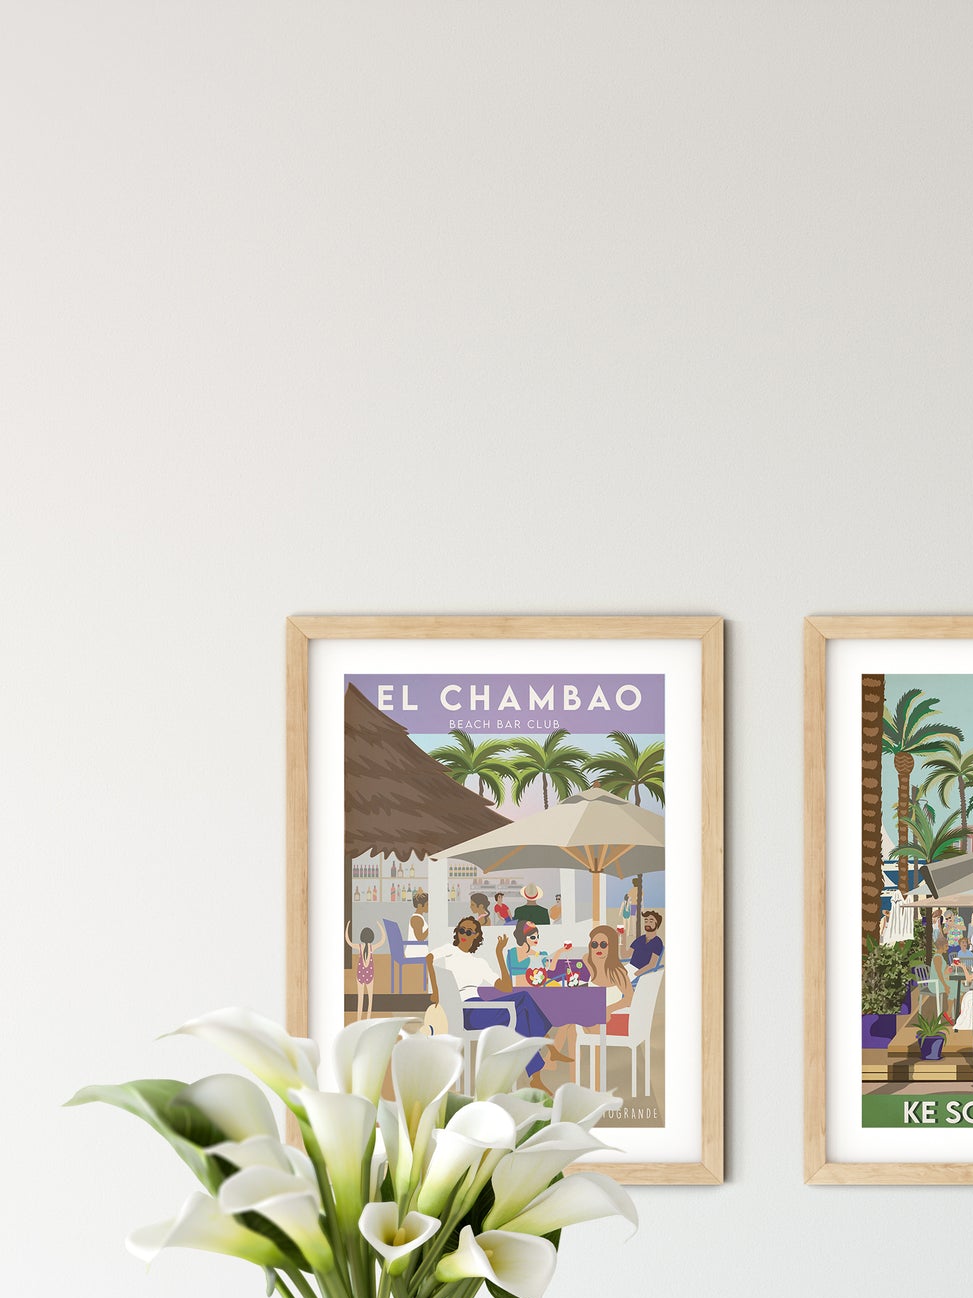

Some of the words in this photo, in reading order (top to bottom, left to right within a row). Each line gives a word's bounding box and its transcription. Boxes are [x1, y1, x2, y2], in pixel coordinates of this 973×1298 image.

[377, 684, 418, 711] EL
[440, 684, 642, 711] CHAMBAO
[449, 719, 490, 729] BEACH
[497, 719, 521, 729] BAR
[527, 719, 561, 729] CLUB
[903, 1101, 938, 1125] KE
